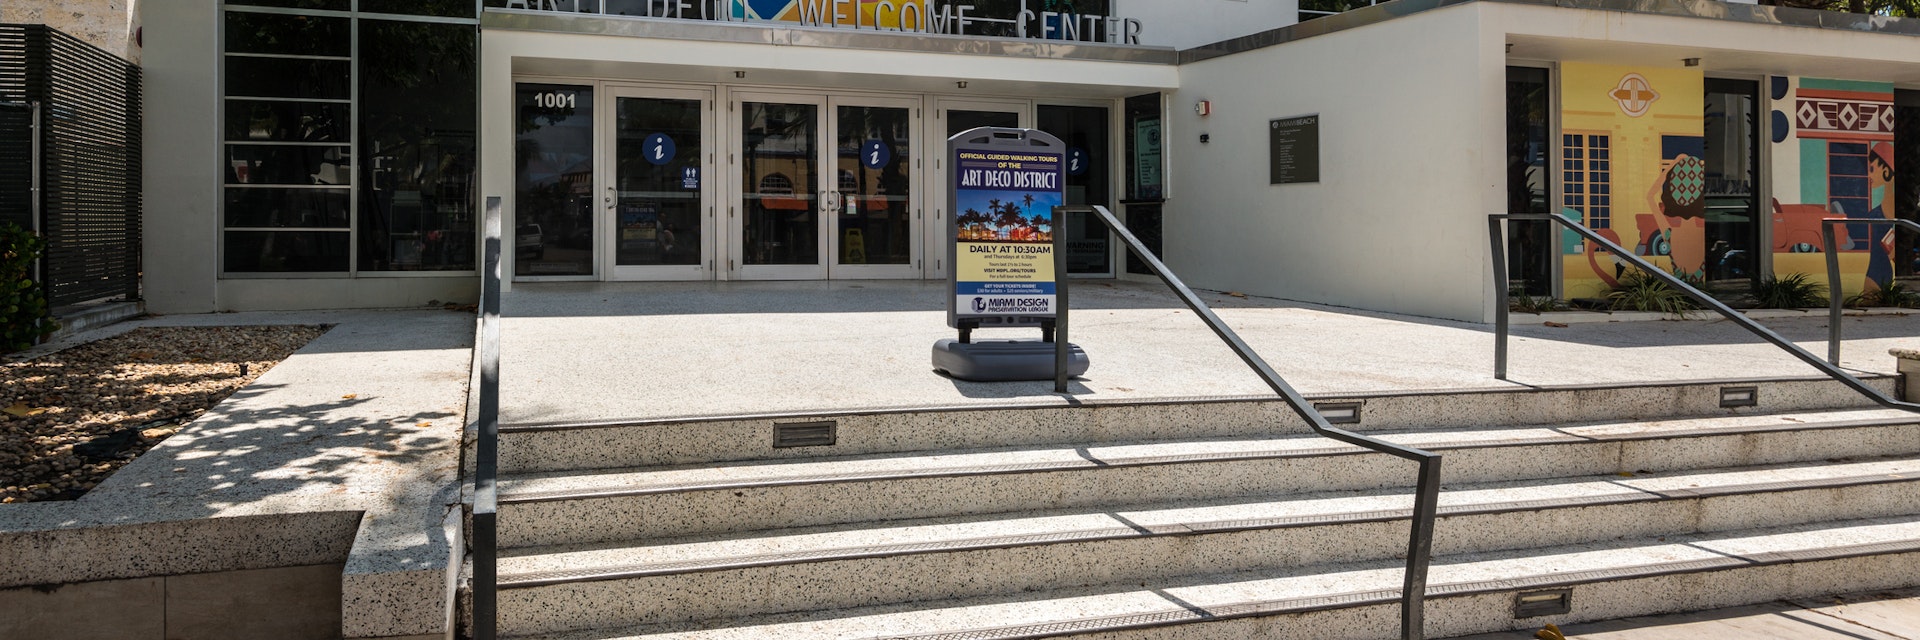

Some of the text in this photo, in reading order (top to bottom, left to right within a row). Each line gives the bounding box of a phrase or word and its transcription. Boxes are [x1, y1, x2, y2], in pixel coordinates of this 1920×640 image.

[797, 0, 974, 35] WELCOME
[1015, 8, 1143, 45] CENTER
[534, 92, 575, 108] 1001
[962, 169, 1056, 188] ART DECO DISTRICT
[970, 245, 997, 253] DAILY
[988, 298, 1048, 306] MIAMI DESIGN
